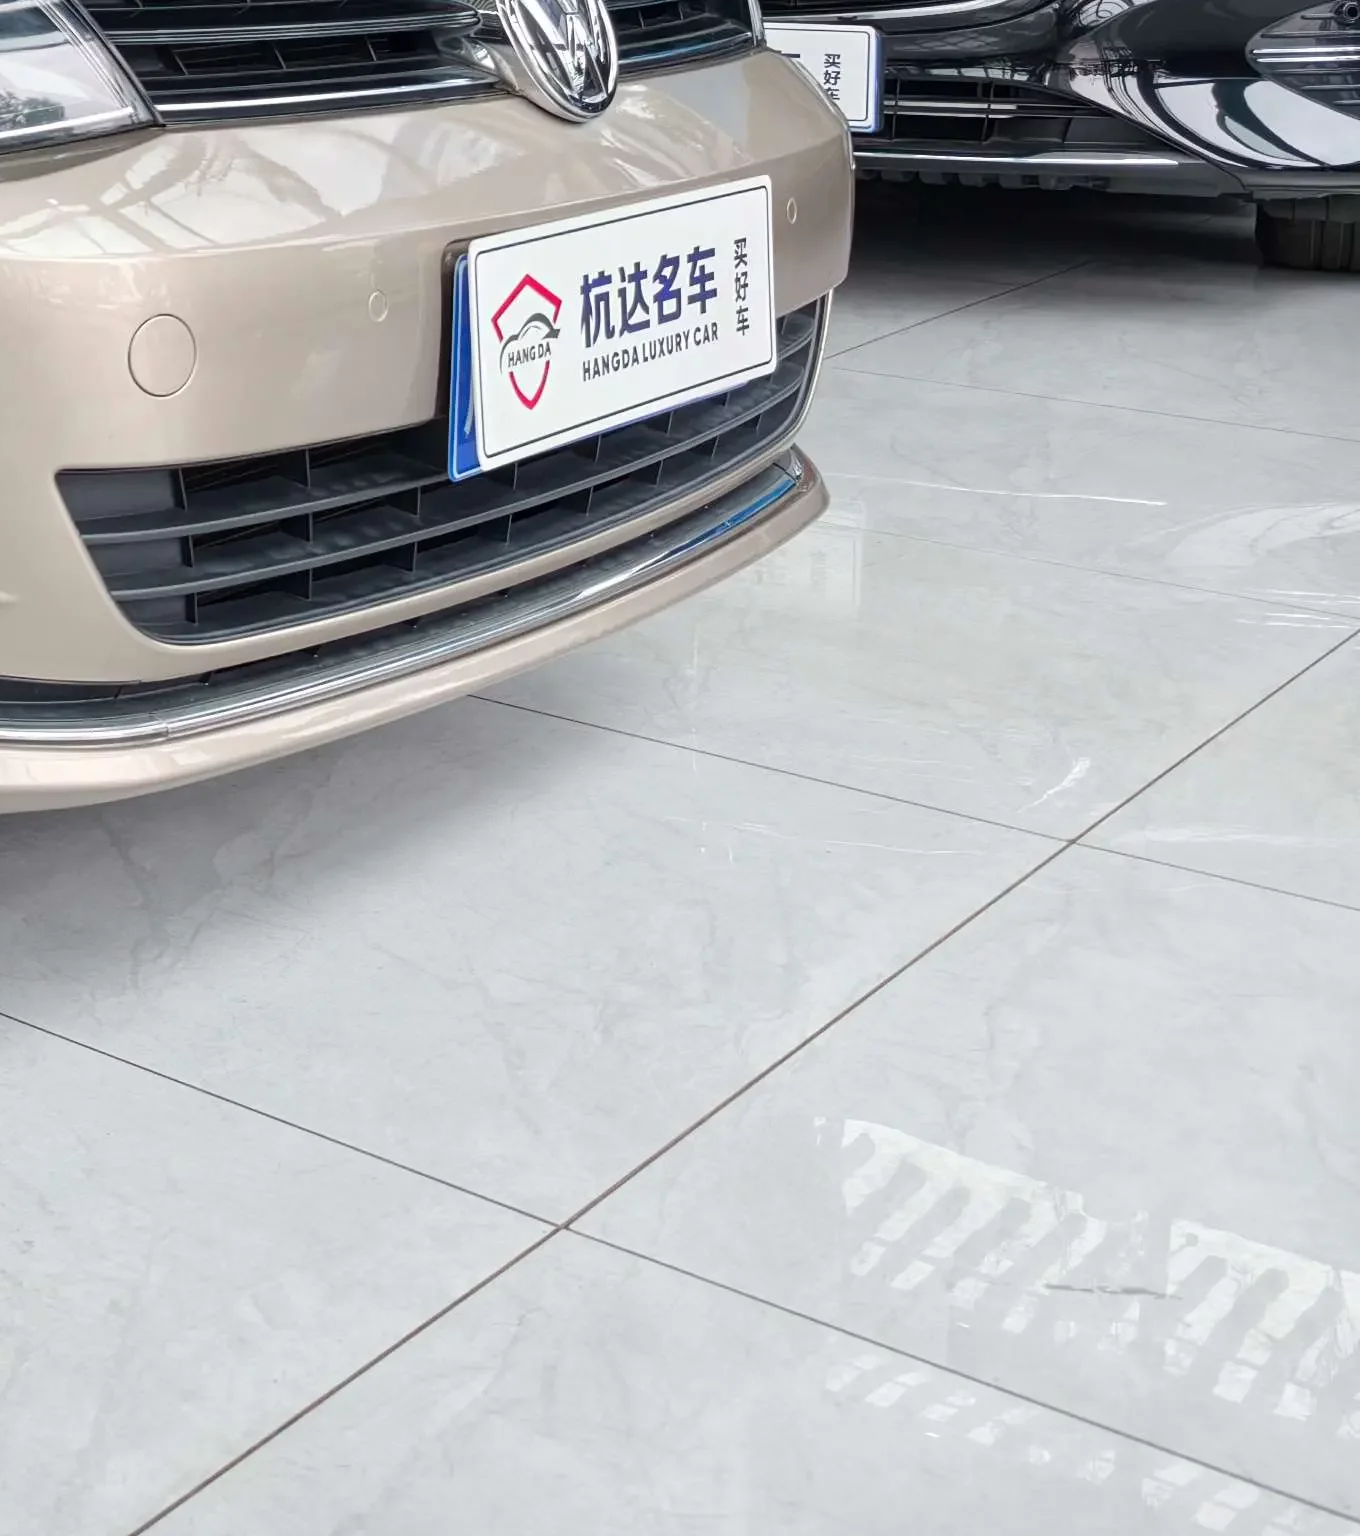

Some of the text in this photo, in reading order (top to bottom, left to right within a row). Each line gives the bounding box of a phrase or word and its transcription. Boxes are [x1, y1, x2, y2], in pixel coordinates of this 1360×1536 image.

[579, 245, 718, 348] 杭达名车
[733, 236, 750, 337] 买好车
[507, 340, 552, 368] HANG DA
[641, 328, 690, 363] LUXURY
[693, 321, 719, 346] CAR
